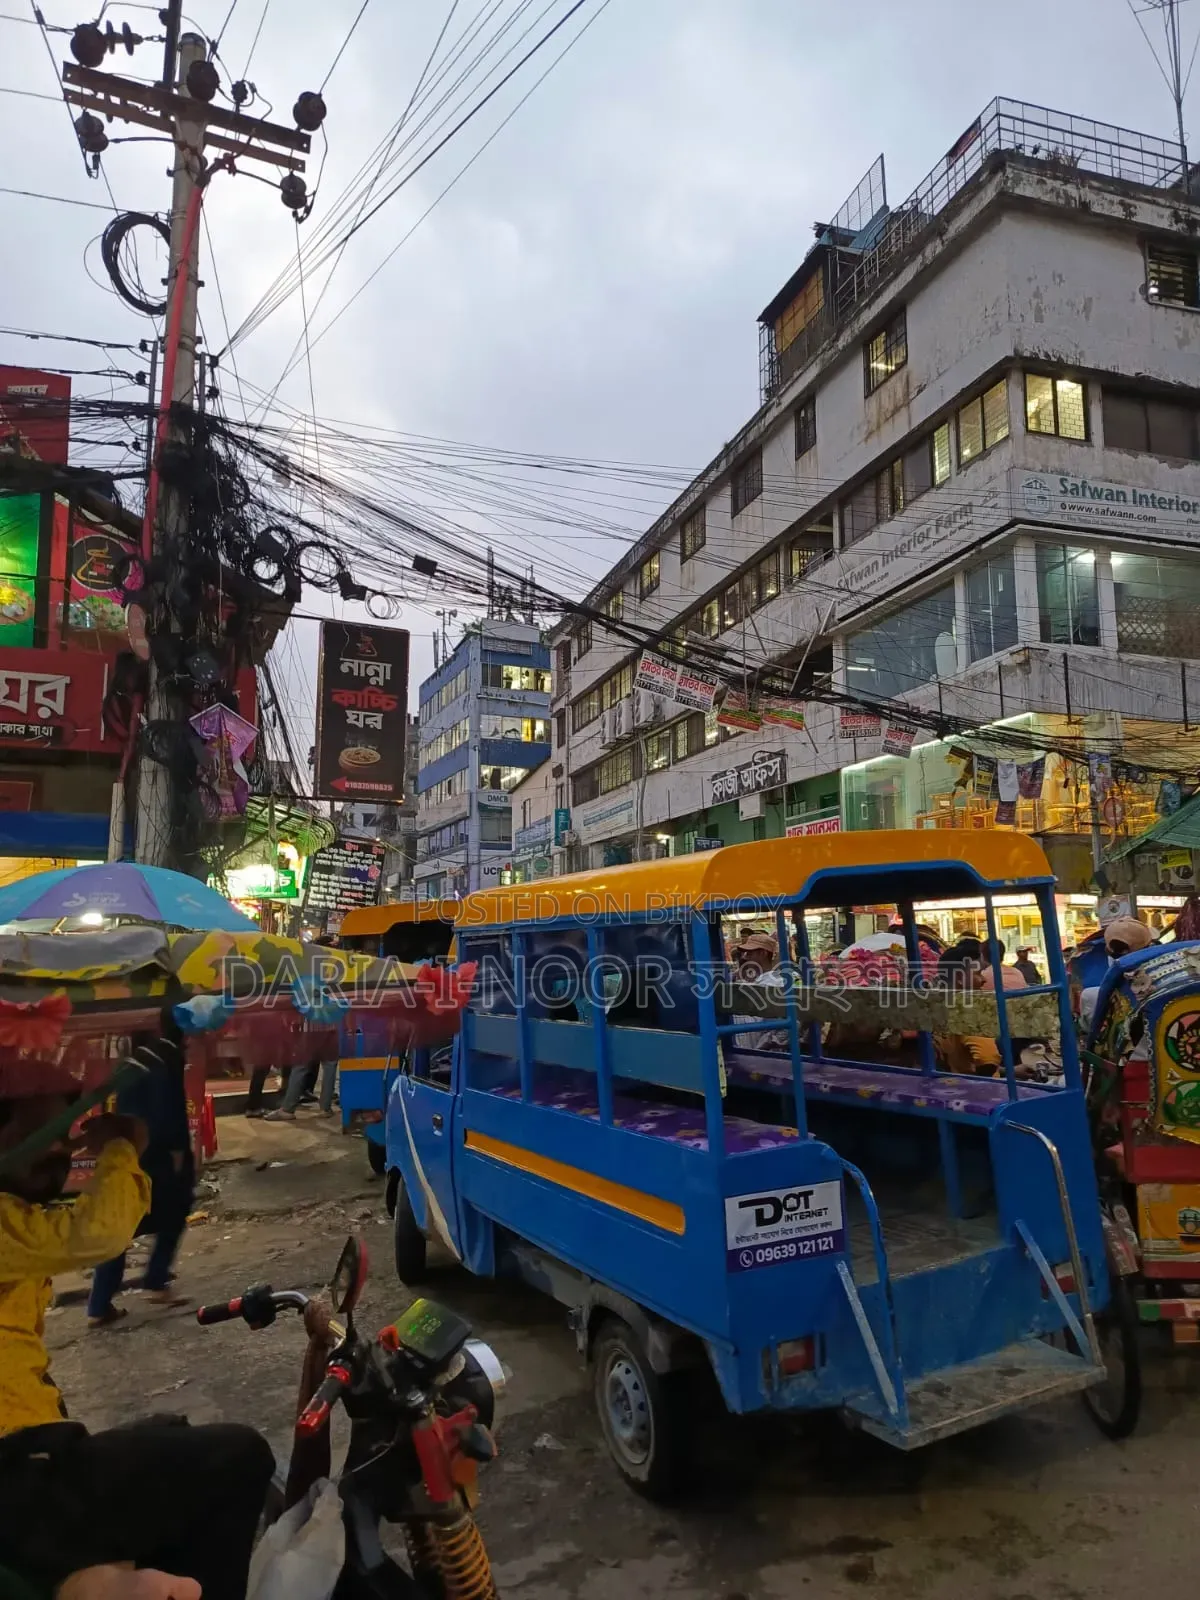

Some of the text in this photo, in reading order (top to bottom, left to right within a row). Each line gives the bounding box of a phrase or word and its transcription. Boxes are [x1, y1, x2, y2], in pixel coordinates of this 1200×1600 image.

[1059, 477, 1200, 514] Safwan Interior
[1068, 503, 1157, 523] www.safwann.com
[881, 526, 932, 568] Interior
[935, 501, 974, 535] Farm
[340, 657, 392, 686] নান্না
[331, 686, 400, 712] কাচ্চি
[28, 724, 54, 737] শাখা
[345, 709, 384, 730] ঘর
[711, 757, 781, 799] কাজী অফিস
[738, 1189, 814, 1228] DOT
[784, 1207, 829, 1223] INTERNET
[756, 1236, 834, 1263] 09639 121 121
